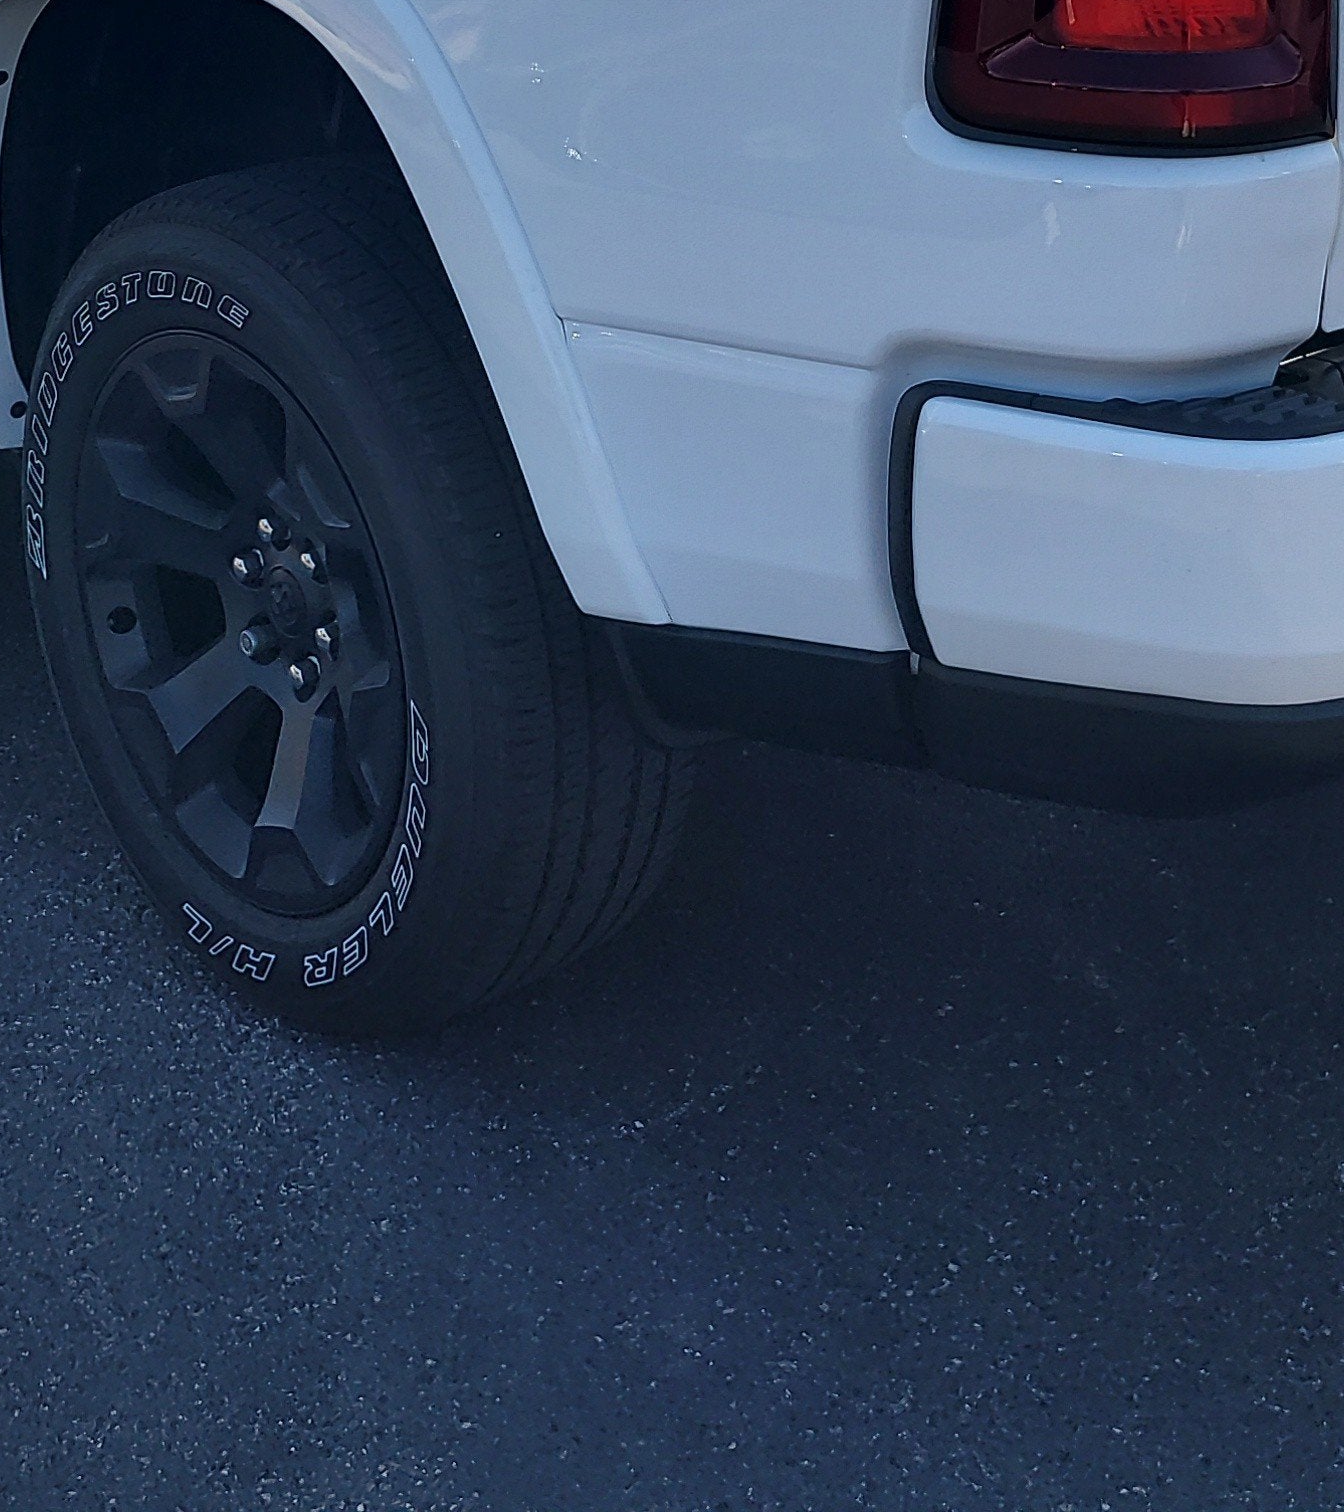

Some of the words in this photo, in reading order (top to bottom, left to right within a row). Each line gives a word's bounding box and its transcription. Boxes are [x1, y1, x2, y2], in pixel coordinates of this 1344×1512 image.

[22, 270, 250, 580] BRIDGESTONE
[182, 902, 277, 982] H/L
[304, 700, 432, 988] DUELER
